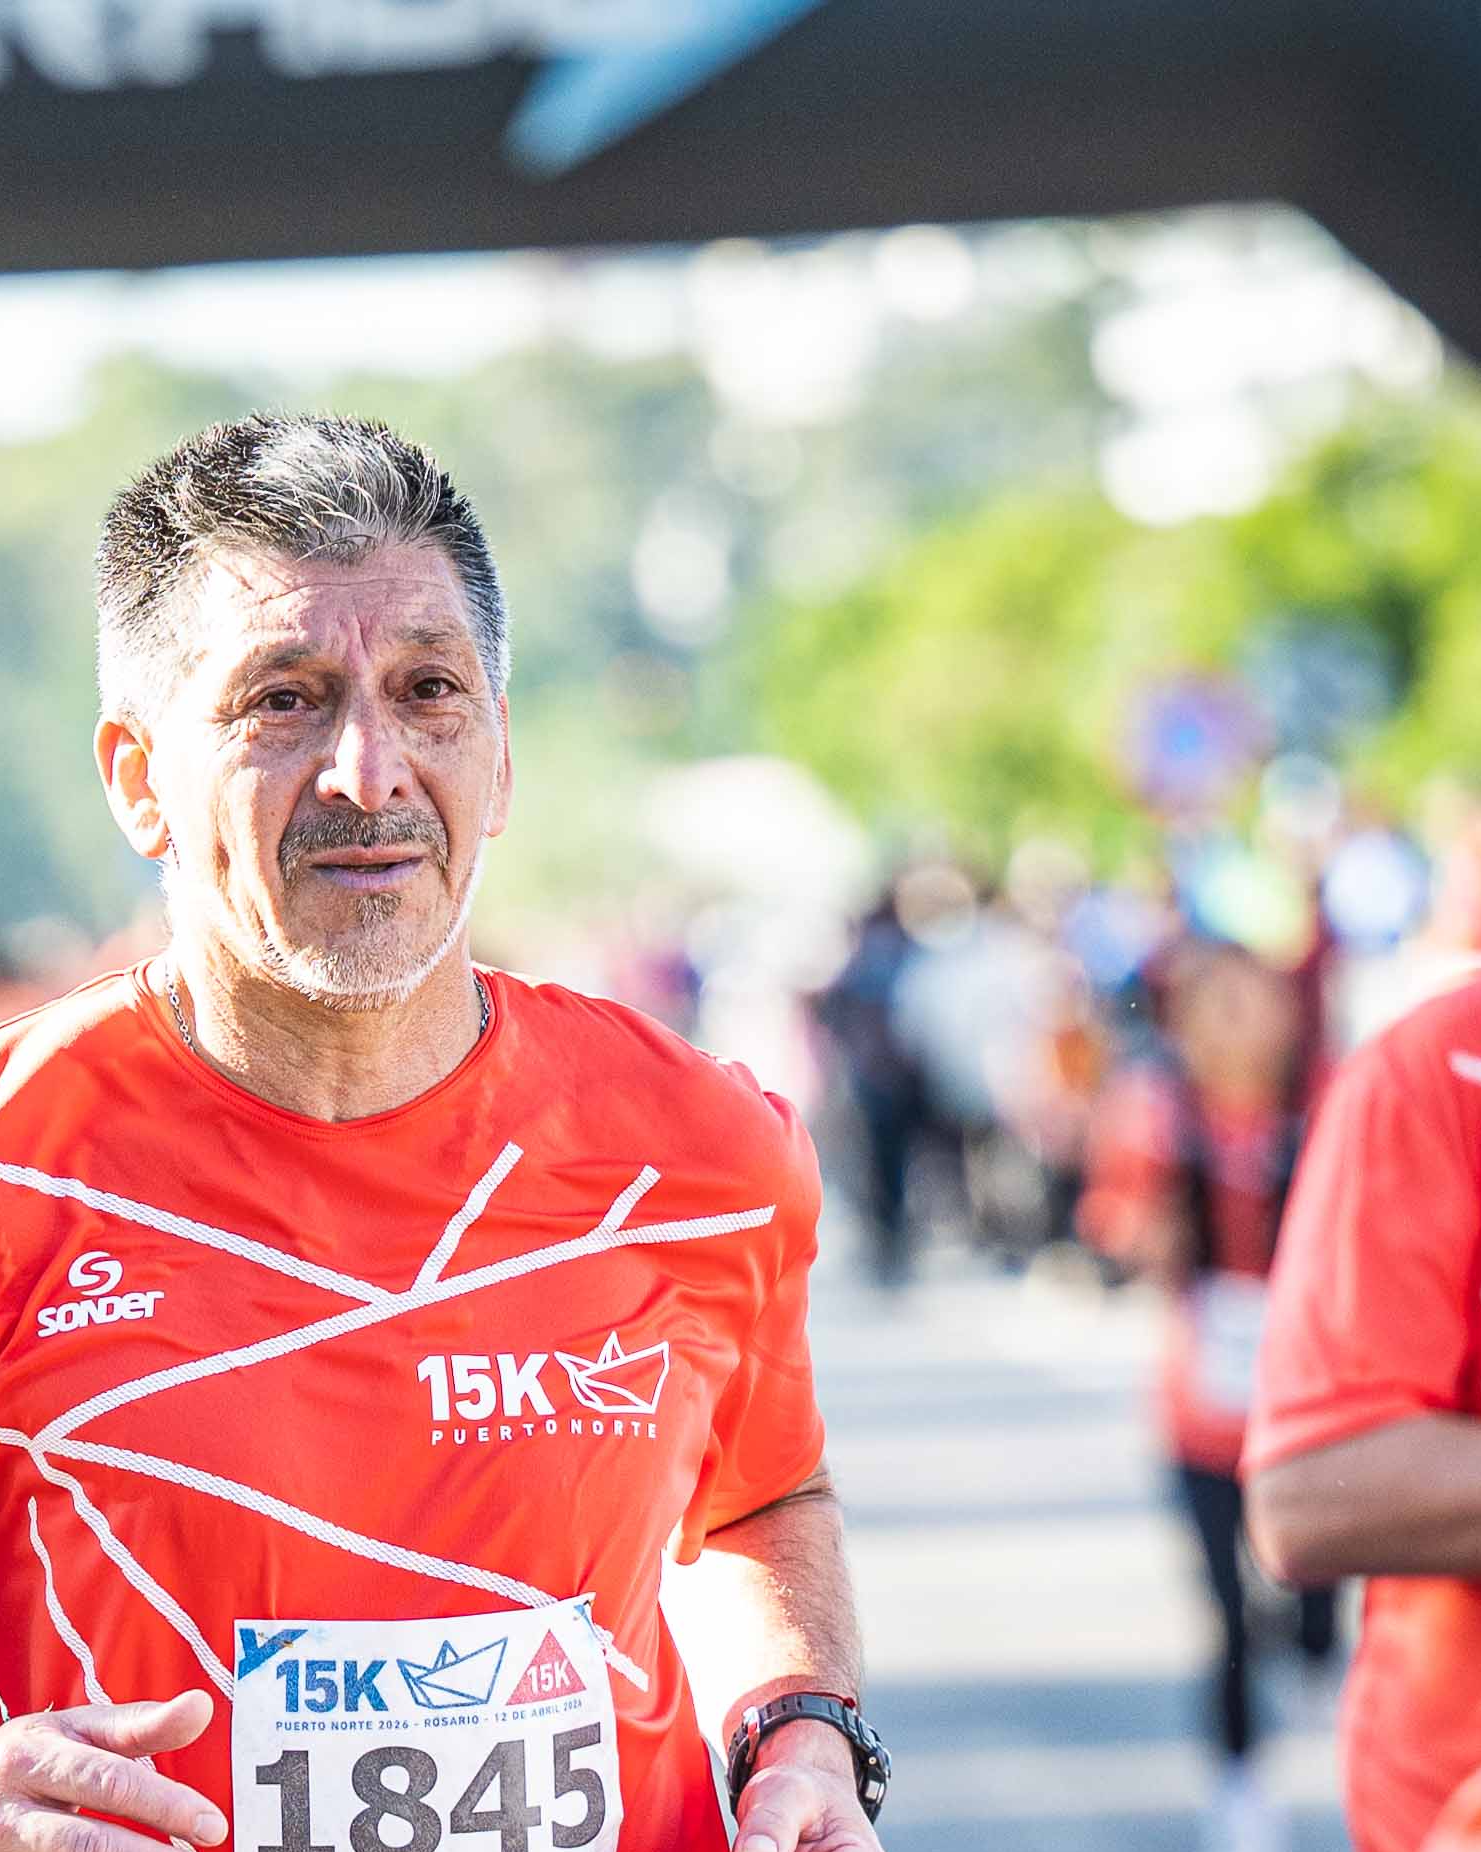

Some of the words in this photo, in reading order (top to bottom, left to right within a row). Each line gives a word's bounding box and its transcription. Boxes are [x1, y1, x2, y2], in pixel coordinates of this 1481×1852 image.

[416, 1353, 556, 1421] 15K
[431, 1419, 557, 1446] PUERTO
[570, 1418, 657, 1439] NORTE
[276, 1658, 389, 1713] 15K
[526, 1659, 571, 1696] 15K
[275, 1720, 326, 1731] PUERTO
[330, 1720, 374, 1731] NORTE
[378, 1719, 410, 1730] 2026
[423, 1715, 480, 1729] ROSARIO
[494, 1712, 507, 1723] 12
[512, 1710, 526, 1721] DE
[531, 1704, 561, 1718] ABRIL
